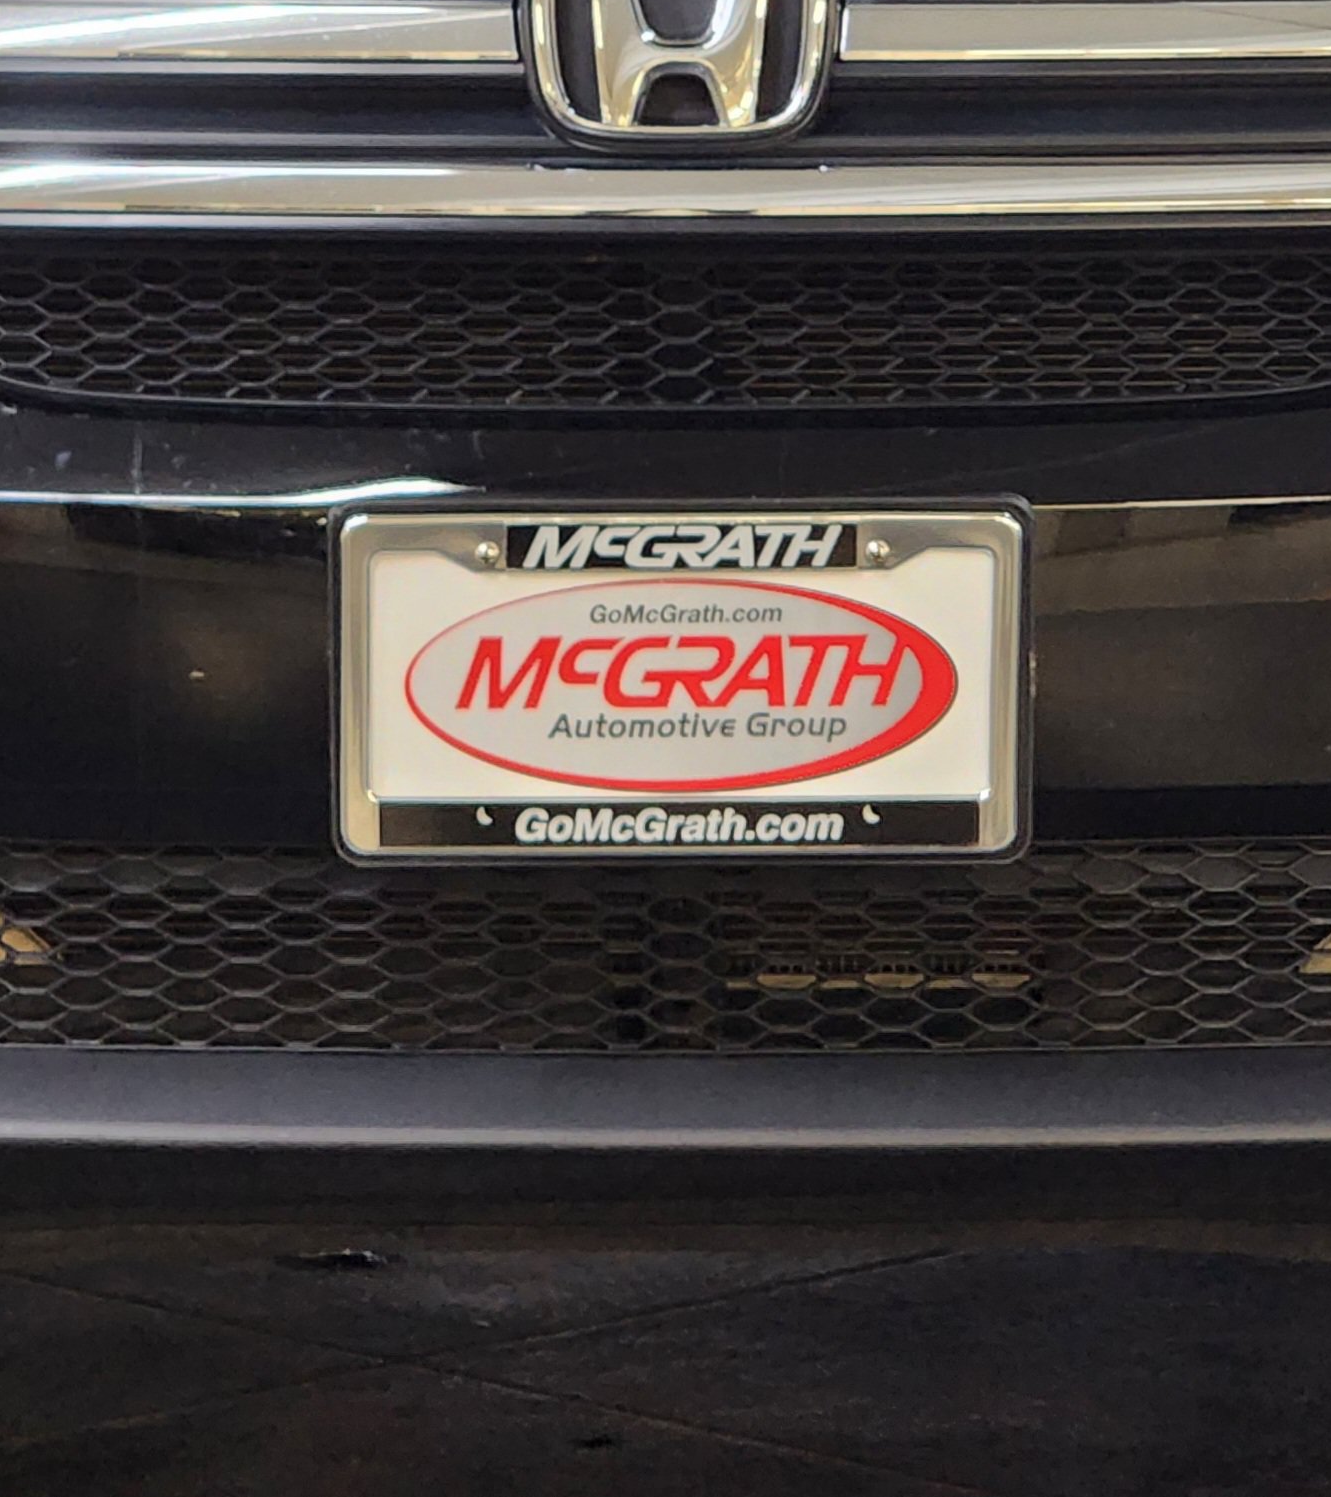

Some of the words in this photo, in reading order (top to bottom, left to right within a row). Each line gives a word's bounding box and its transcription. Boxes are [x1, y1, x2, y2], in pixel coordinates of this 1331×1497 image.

[589, 603, 783, 625] GoMcGrath.com
[548, 712, 737, 739] Automotive
[745, 712, 849, 742] Group
[514, 806, 843, 844] GoMcGrath.com
